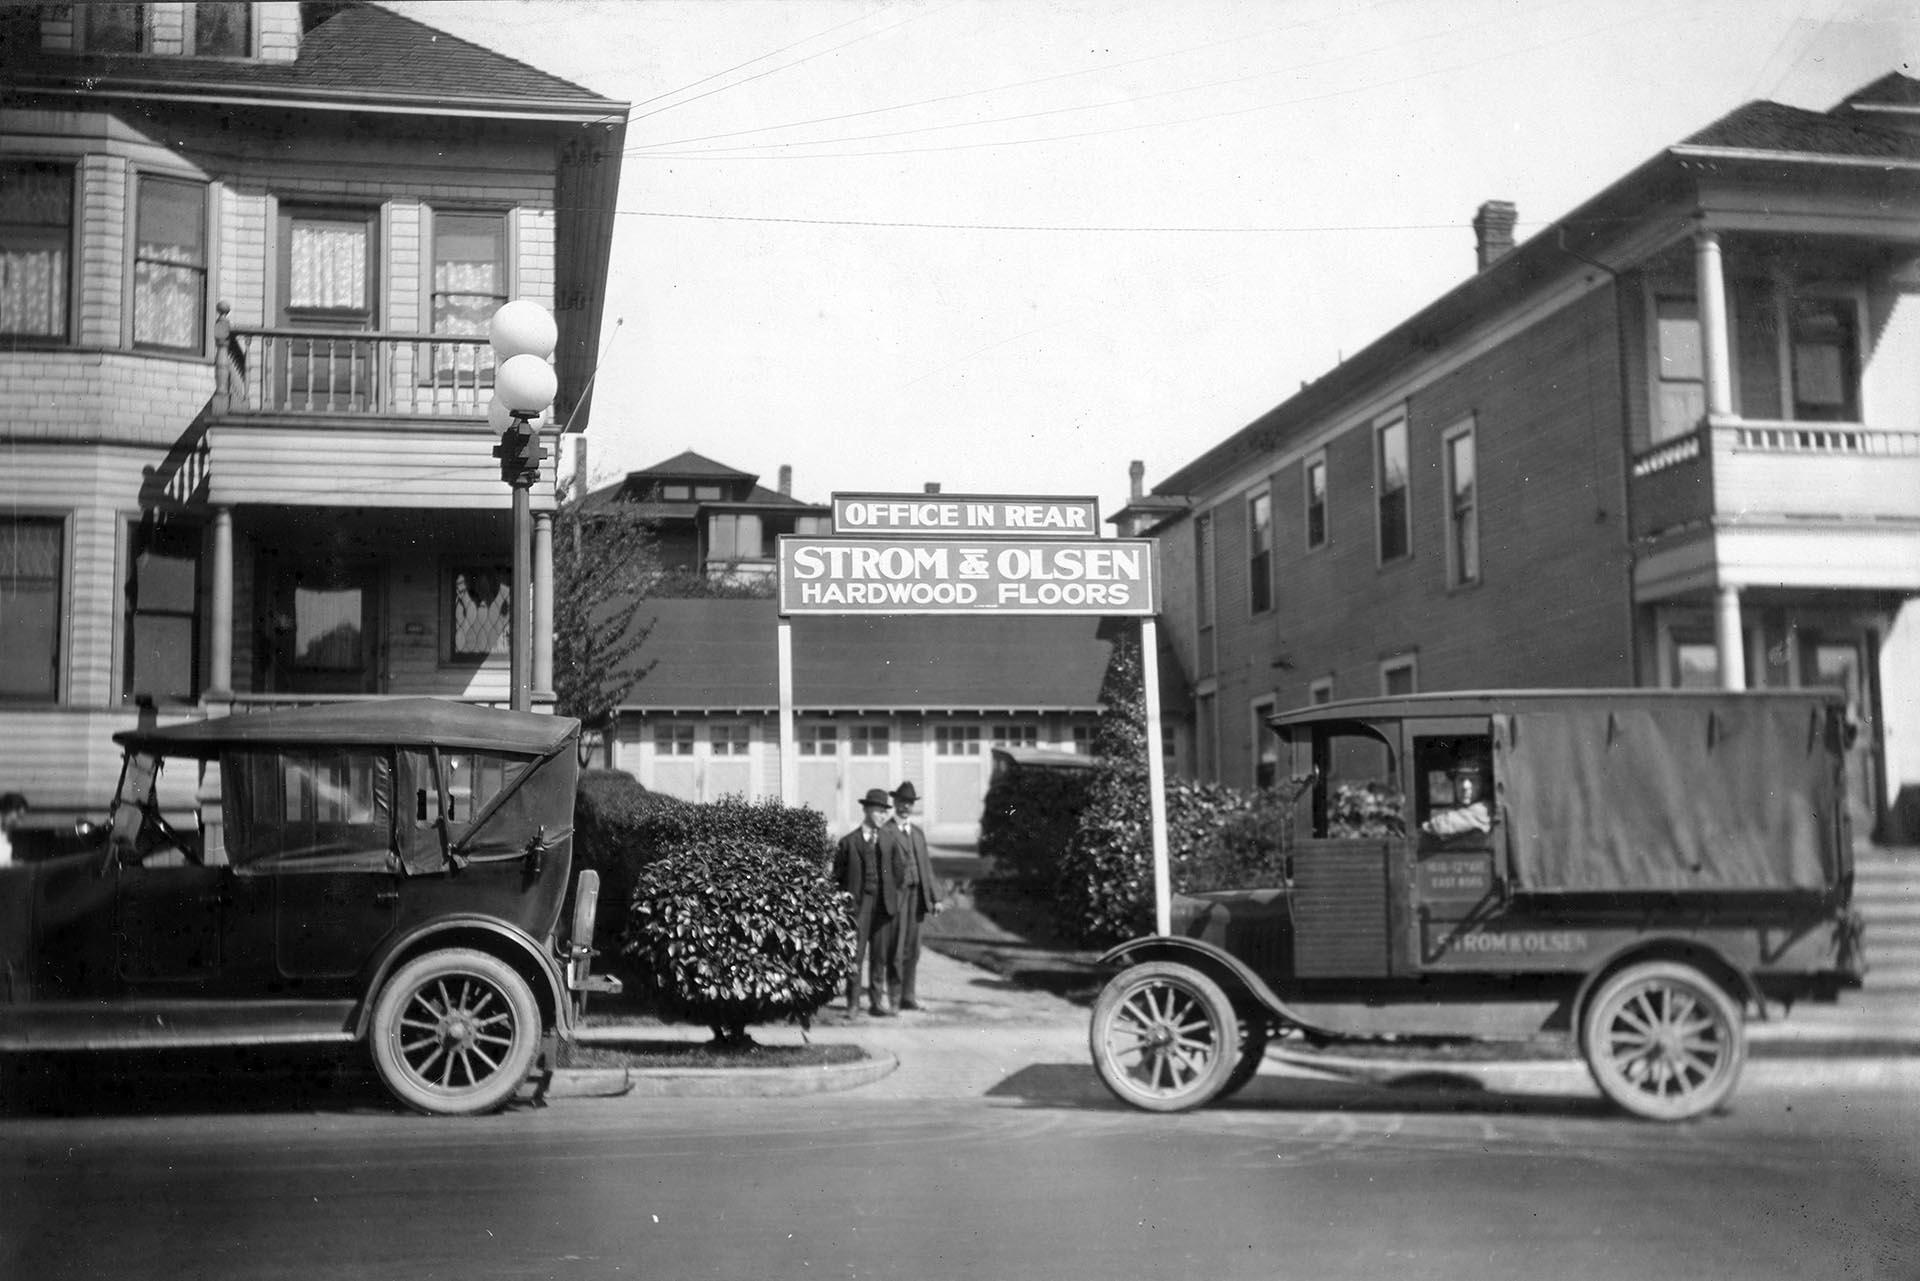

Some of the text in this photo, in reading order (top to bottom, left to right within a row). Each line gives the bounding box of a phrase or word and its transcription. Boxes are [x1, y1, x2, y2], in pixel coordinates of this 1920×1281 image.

[845, 502, 1086, 528] OFFICE IN REAR
[793, 545, 1140, 580] STROM & OLSEN
[801, 583, 1131, 605] HARDWOOD FLOORS
